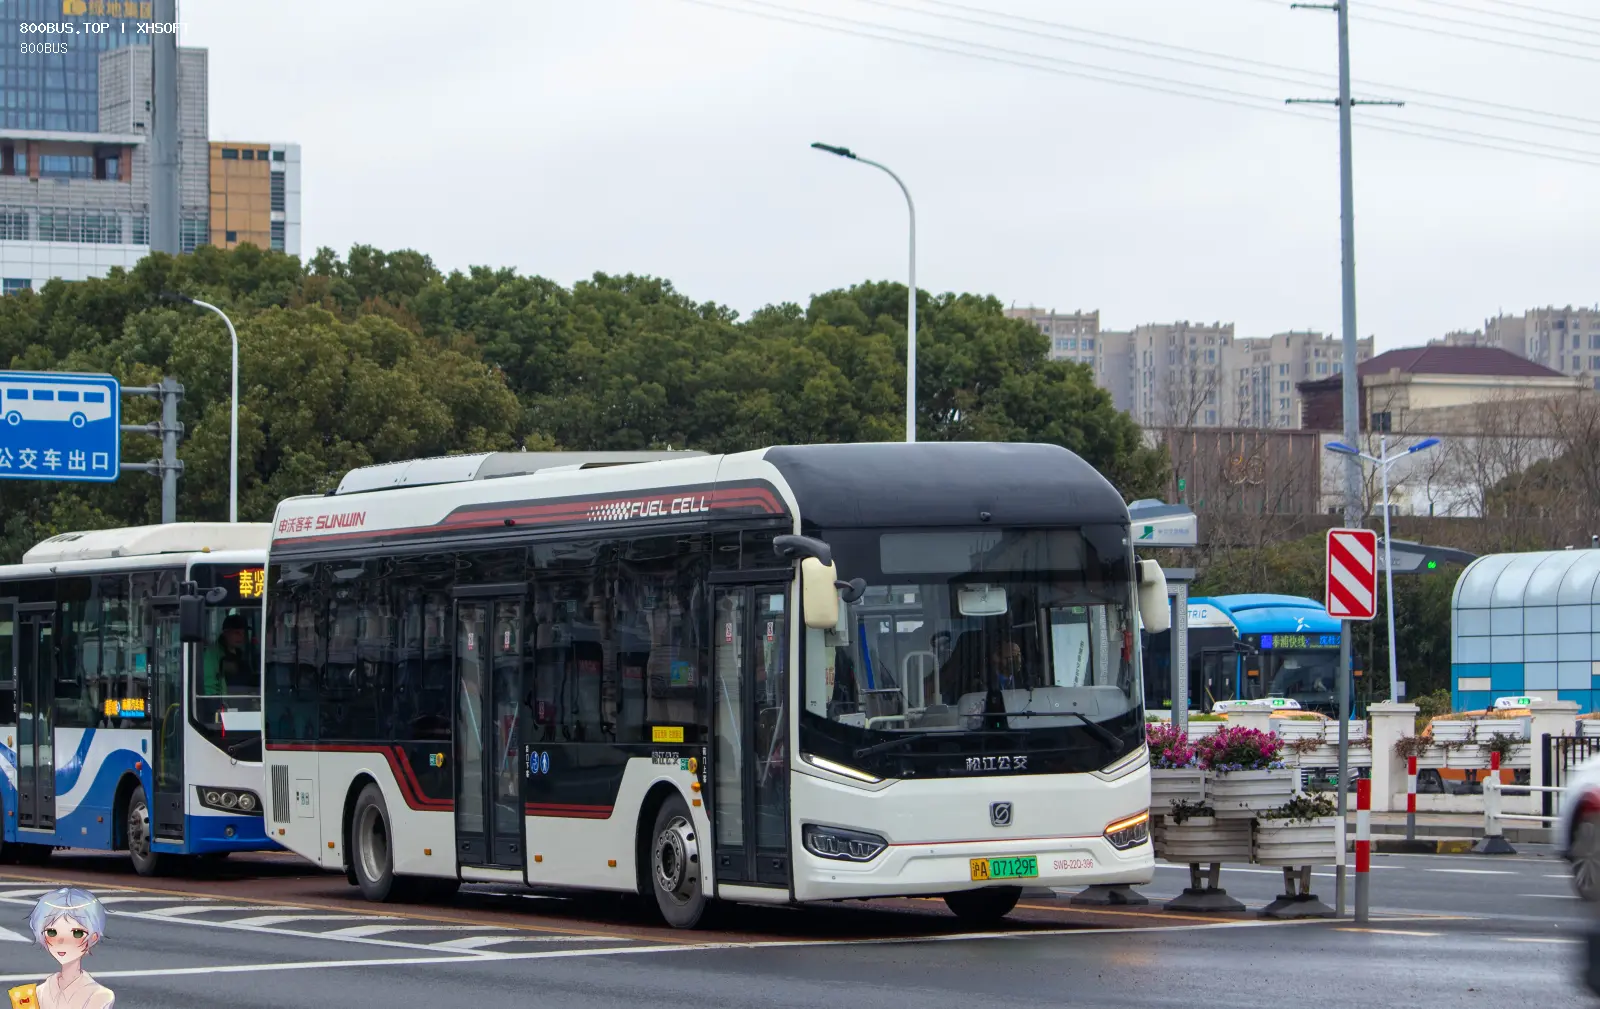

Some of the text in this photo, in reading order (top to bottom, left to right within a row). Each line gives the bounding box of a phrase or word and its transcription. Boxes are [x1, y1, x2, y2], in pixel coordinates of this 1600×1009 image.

[0, 447, 109, 471] 公交车出口
[629, 496, 709, 518] FUEL CELL
[278, 511, 366, 533] 申沃客车 SUNWIN
[1188, 609, 1207, 619] TRIC
[651, 751, 679, 765] 松江公交
[965, 755, 1028, 771] 松江公交
